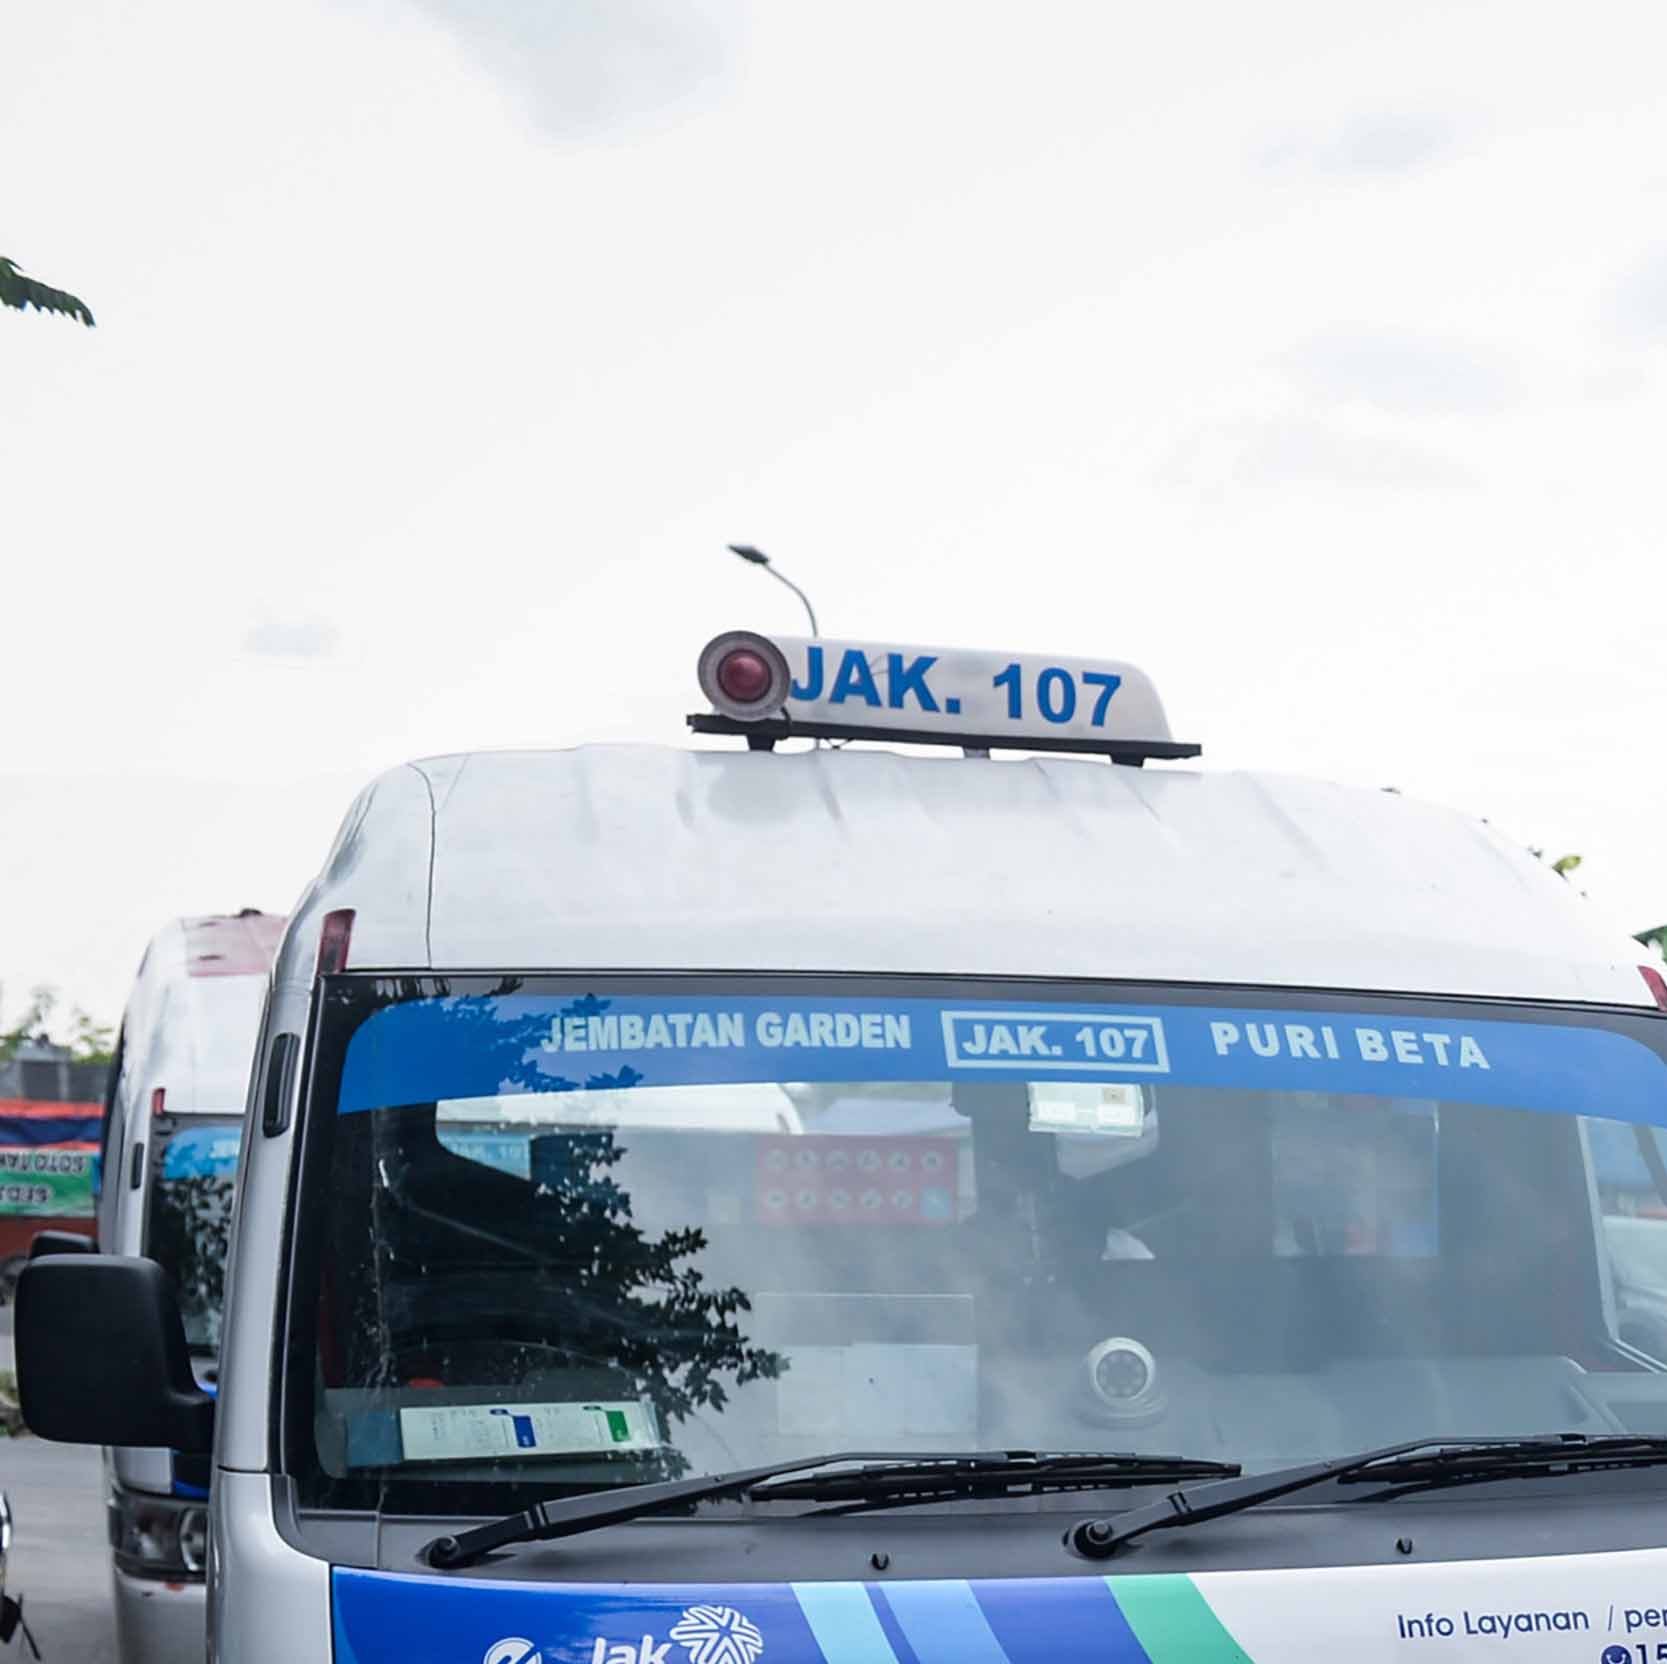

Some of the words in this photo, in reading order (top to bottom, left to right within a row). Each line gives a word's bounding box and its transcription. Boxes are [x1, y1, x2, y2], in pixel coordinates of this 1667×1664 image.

[790, 645, 963, 716] JAK.
[993, 663, 1122, 729] 107
[541, 1011, 745, 1053] JEMBATAN
[756, 1011, 912, 1050] GARDEN
[961, 1023, 1063, 1057] JAK.
[1080, 1025, 1149, 1061] 107
[1210, 1020, 1341, 1061] PURI
[1355, 1027, 1491, 1071] BETA
[1397, 1613, 1455, 1639] Info
[1463, 1608, 1590, 1640] Layanan
